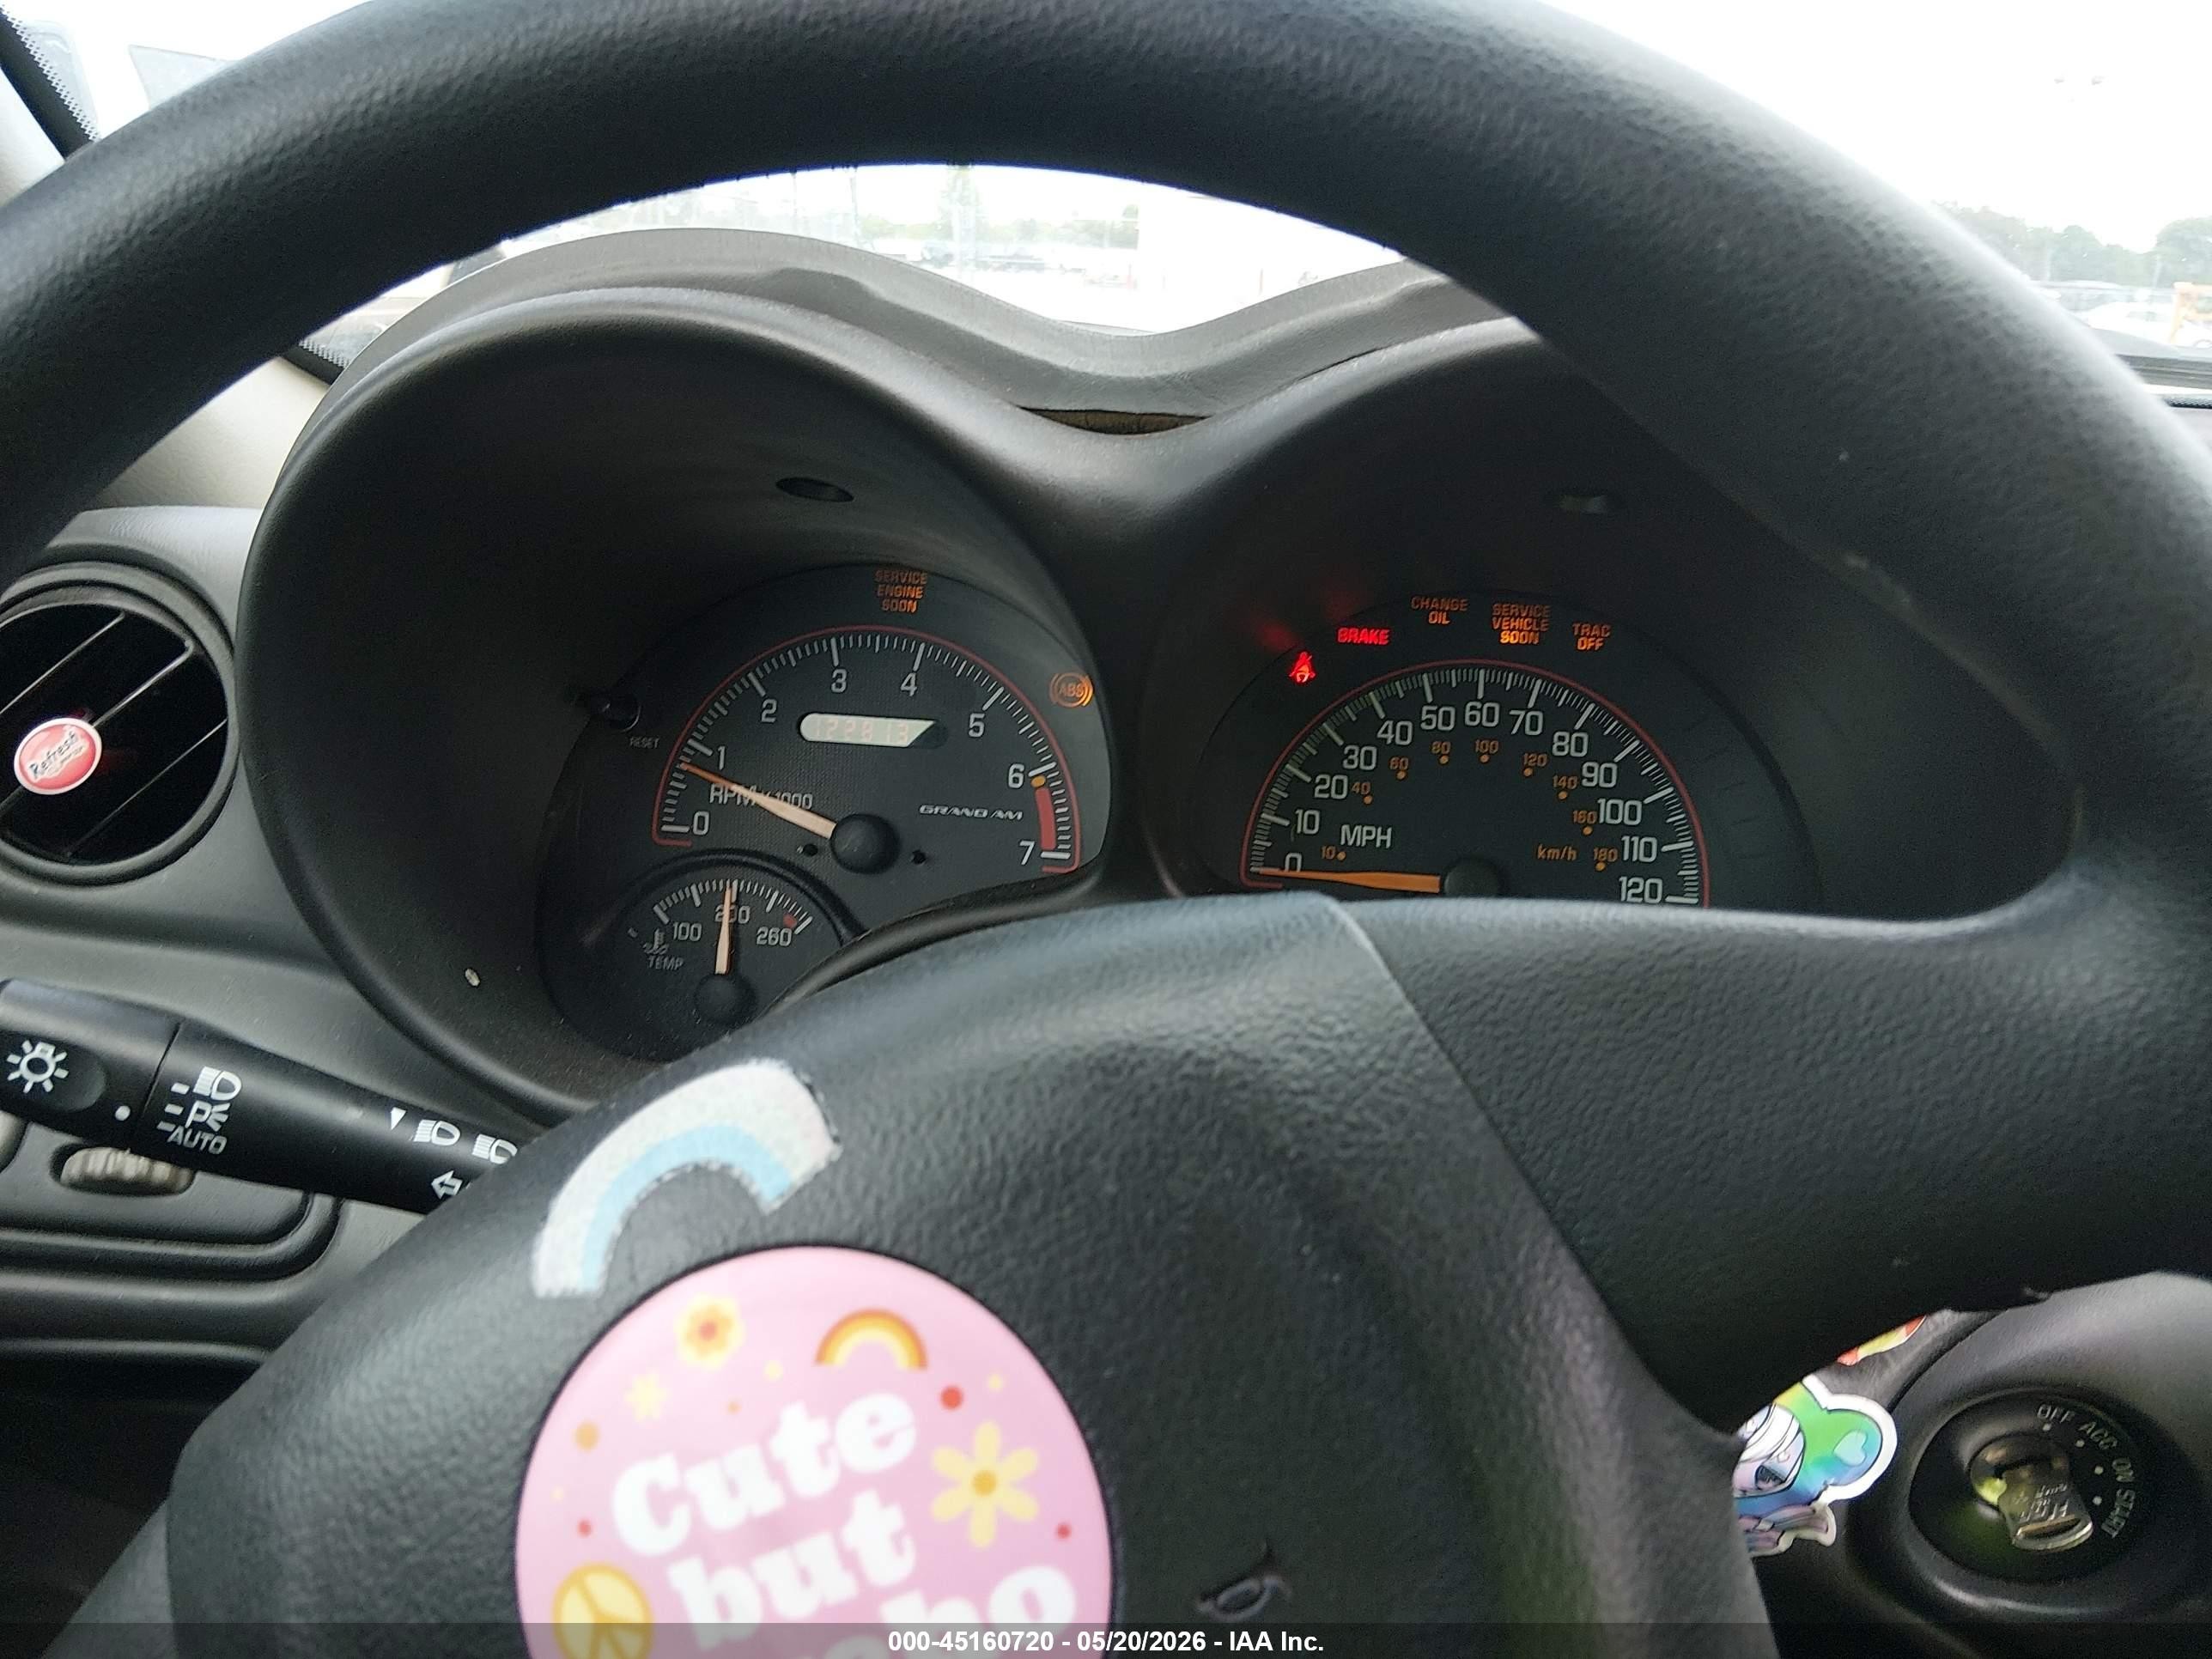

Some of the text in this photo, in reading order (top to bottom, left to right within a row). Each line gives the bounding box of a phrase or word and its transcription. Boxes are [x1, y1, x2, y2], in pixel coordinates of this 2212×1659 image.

[874, 570, 927, 584] SERVICE
[878, 585, 923, 599] ENGINE
[882, 599, 917, 612] SOON
[1411, 597, 1468, 611] CHANGE
[1492, 604, 1551, 617] SERVICE
[1428, 611, 1450, 624] OIL
[1492, 617, 1550, 631] VEHICLE
[1338, 628, 1390, 645] BRAKE
[1500, 630, 1540, 645] SOON
[1572, 623, 1611, 637] TRAC
[1577, 636, 1604, 650] OFF
[831, 670, 847, 694] 3
[901, 673, 919, 696] 4
[1058, 682, 1084, 698] ABS
[761, 700, 778, 724] 2
[1420, 705, 1455, 731] 50
[1465, 702, 1500, 727] 60
[969, 714, 985, 738] 5
[1509, 710, 1544, 735] 70
[1377, 720, 1413, 745] 40
[629, 737, 660, 749] RESET
[1431, 741, 1451, 754] 80
[1474, 739, 1498, 752] 100
[1552, 731, 1589, 757] 80
[716, 745, 726, 769] 1
[1342, 744, 1377, 770] 30
[1389, 757, 1409, 769] 60
[1523, 753, 1547, 766] 120
[1008, 763, 1025, 788] 6
[1553, 775, 1578, 789] 140
[1581, 762, 1618, 787] 90
[1314, 775, 1348, 799] 20
[1351, 781, 1371, 795] 40
[920, 805, 1024, 821] GRAND AM
[1572, 811, 1597, 824] 160
[1597, 799, 1642, 825] 100
[692, 811, 709, 836] 0
[1295, 809, 1321, 835] 10
[1340, 824, 1392, 848] MPH
[1019, 841, 1036, 866] 7
[1322, 846, 1336, 860] 10
[1537, 844, 1577, 861] km/h
[1593, 848, 1619, 862] 180
[1621, 836, 1657, 862] 110
[1285, 853, 1302, 872] 0
[1619, 877, 1663, 903] 120
[673, 921, 702, 941] 100
[756, 927, 792, 946] 260
[647, 956, 684, 970] TEMP
[167, 1126, 228, 1155] AUTO
[611, 1392, 918, 1557] Cute
[667, 1489, 917, 1650] but
